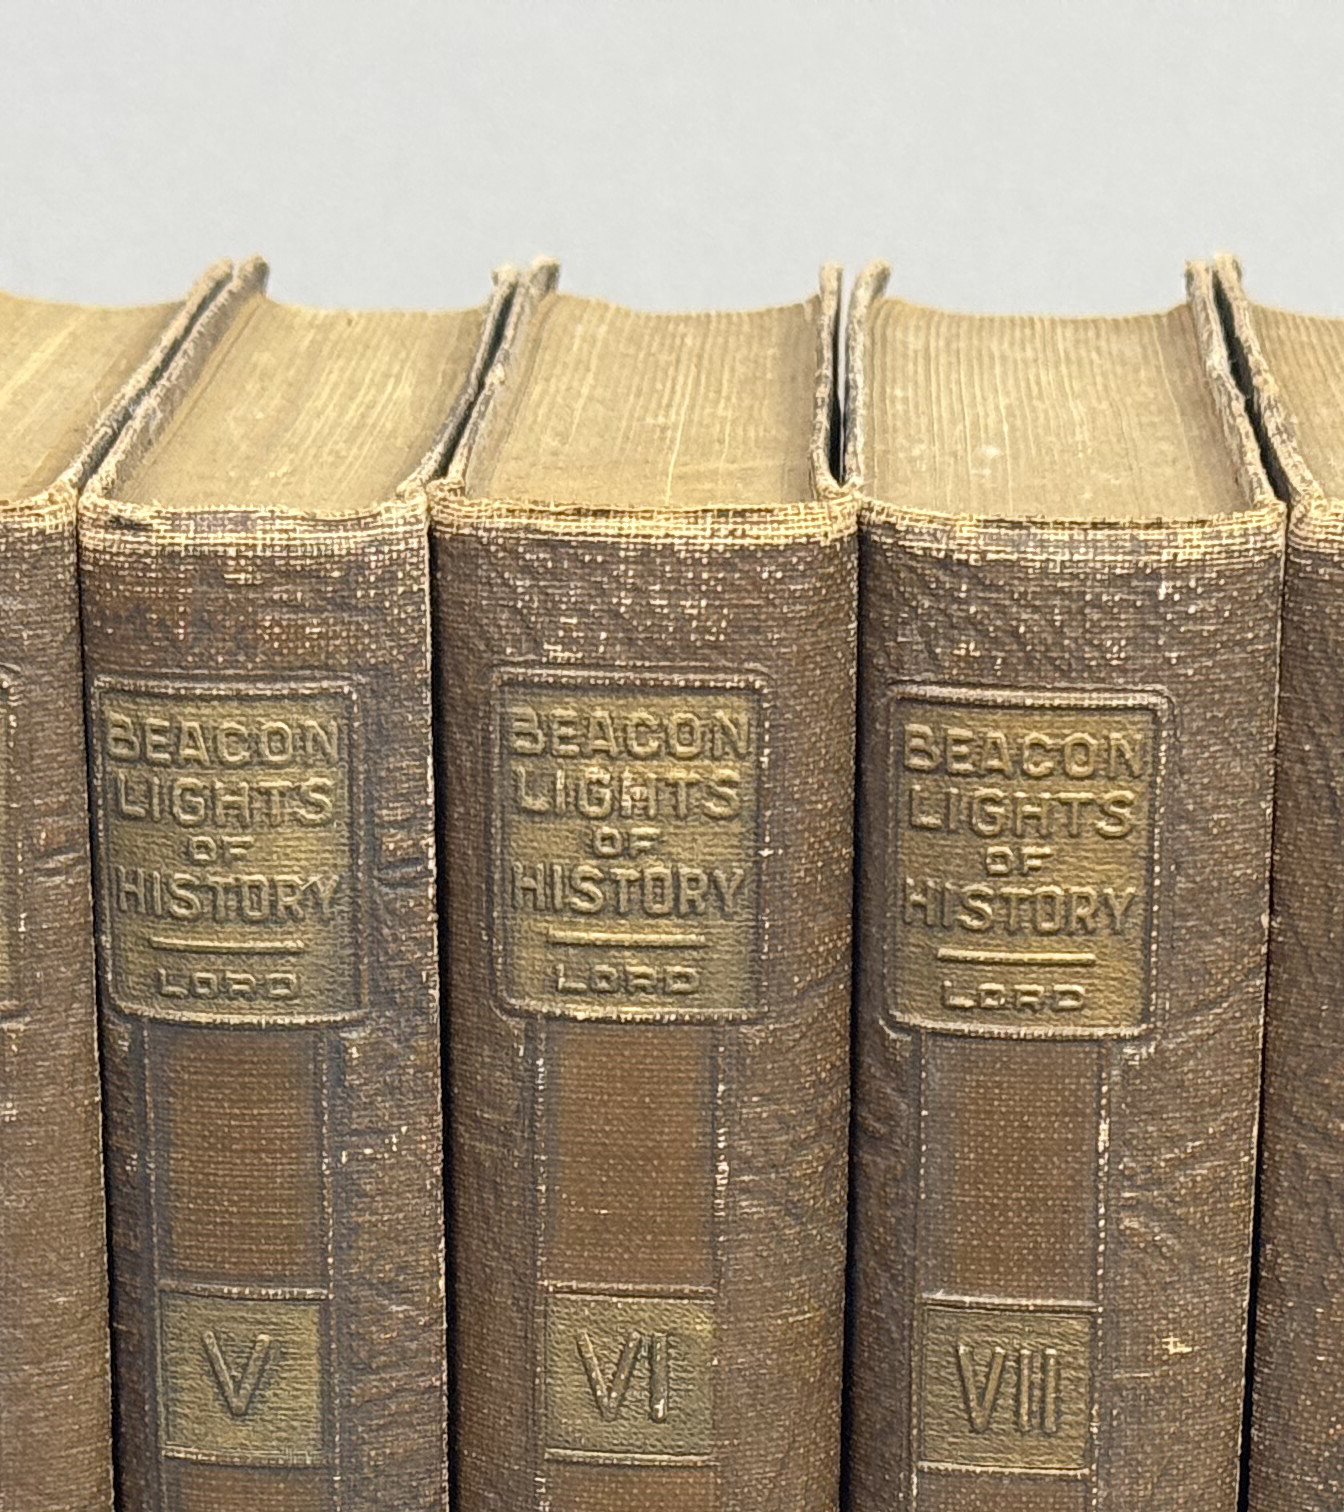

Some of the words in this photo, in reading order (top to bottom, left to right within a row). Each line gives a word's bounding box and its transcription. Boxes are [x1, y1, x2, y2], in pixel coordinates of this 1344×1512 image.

[105, 715, 341, 768] BEACON
[508, 707, 752, 762] BEACON
[902, 722, 1146, 781] BEACON
[115, 771, 335, 827] LIGHTS
[514, 764, 743, 820] LIGHTS
[907, 784, 1138, 840] LIGHTS
[189, 835, 254, 864] OF
[592, 827, 661, 858] OF
[984, 844, 1053, 877] OF
[114, 870, 341, 922] HISTORY
[511, 863, 746, 917] HISTORY
[902, 876, 1138, 936] HISTORY
[156, 965, 301, 999] LORD
[557, 963, 701, 995] LORD
[941, 978, 1087, 1012] LORD
[201, 1330, 272, 1416] V
[576, 1328, 669, 1423] VI
[957, 1341, 1056, 1438] VII
